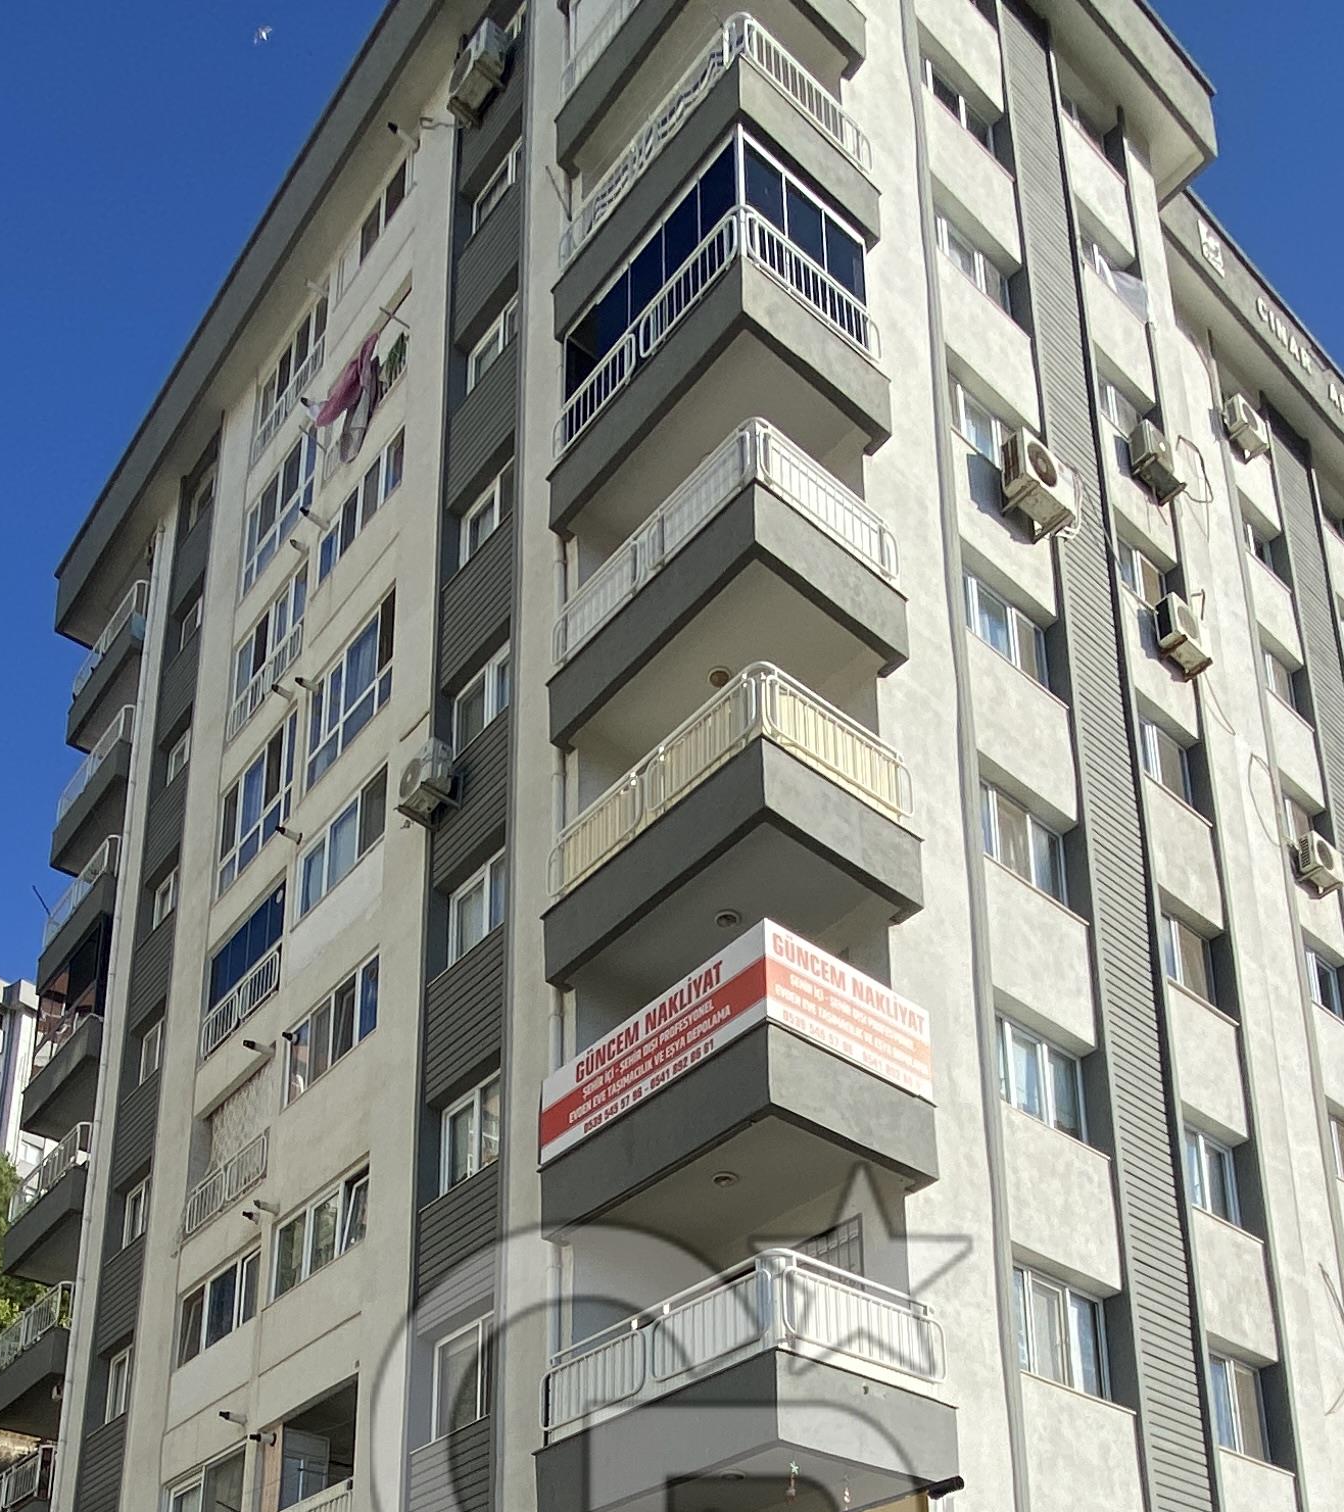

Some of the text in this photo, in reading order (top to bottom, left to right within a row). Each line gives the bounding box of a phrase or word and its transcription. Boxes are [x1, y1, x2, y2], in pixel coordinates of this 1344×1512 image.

[576, 1021, 640, 1083] GÜNCEM
[645, 960, 723, 1034] NAKLİYAT
[687, 1005, 731, 1043] DEPOLAMA
[772, 932, 846, 992] GÜNCEM
[852, 977, 925, 1036] NAKLİYAT
